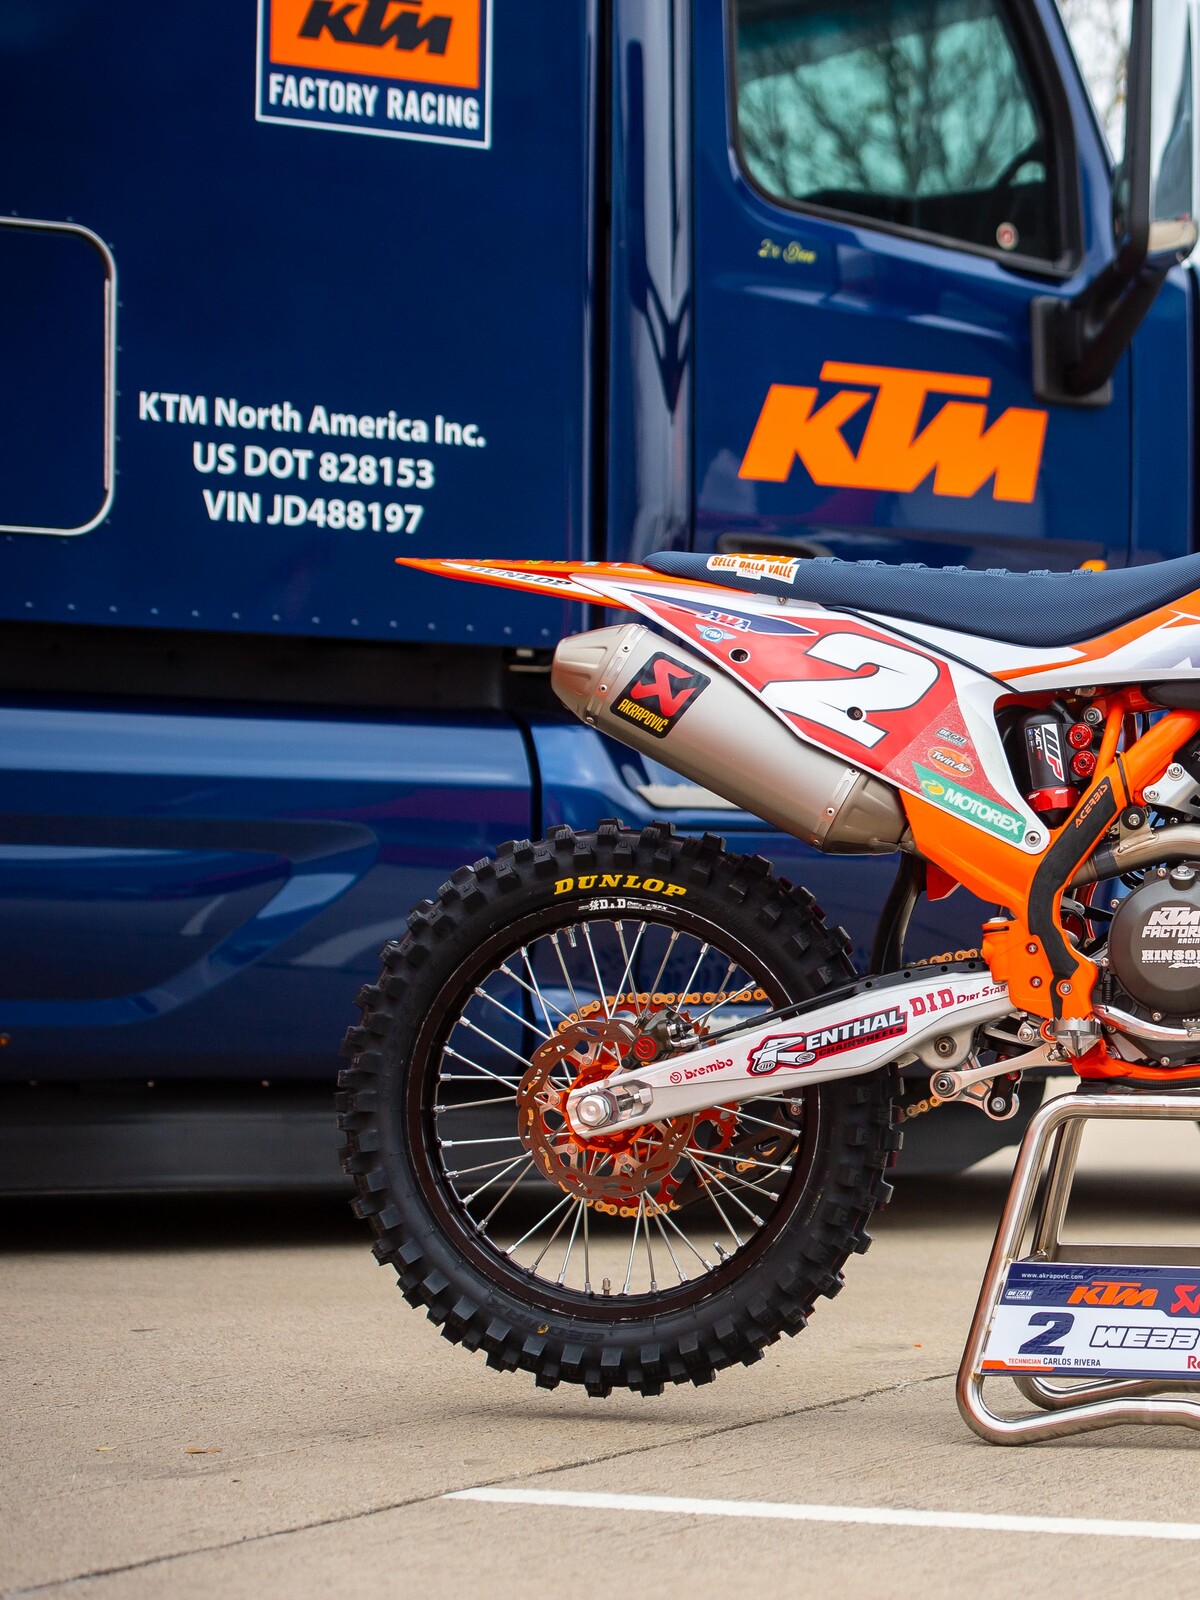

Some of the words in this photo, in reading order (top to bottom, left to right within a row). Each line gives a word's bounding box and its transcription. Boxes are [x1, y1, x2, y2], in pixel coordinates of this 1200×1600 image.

[298, 0, 453, 56] KTM
[269, 72, 379, 118] FACTORY
[386, 86, 480, 130] RACING
[138, 391, 207, 425] KTM
[214, 397, 301, 432] North
[308, 405, 429, 443] America
[434, 415, 486, 448] Inc.
[738, 360, 1048, 502] KTM
[193, 441, 237, 475] US
[244, 446, 314, 480] DOT
[319, 452, 435, 489] 828153
[202, 489, 261, 524] VIN
[266, 494, 424, 534] JD488197
[467, 565, 564, 587] DUNLOP
[711, 556, 737, 568] SELLE
[738, 560, 765, 572] DALLA
[768, 564, 793, 578] VALLE
[705, 630, 721, 640] FIM
[760, 632, 940, 750] 2
[931, 750, 956, 767] Twin
[953, 762, 972, 773] Air
[943, 788, 1026, 835] MOTOREX
[553, 874, 687, 897] DUNLOP
[1147, 907, 1200, 926] KTM
[909, 987, 955, 1017] D.I.D
[819, 1026, 904, 1056] CHAINWHEELS
[685, 1058, 734, 1080] brembo
[1021, 1272, 1084, 1280] www.akrapovic.com
[1067, 1281, 1158, 1307] KTM
[1018, 1311, 1075, 1355] 2
[1089, 1325, 1200, 1351] WEBB
[1008, 1357, 1042, 1365] TECHNICIAN
[1043, 1357, 1072, 1366] CARLOS
[1074, 1358, 1101, 1367] RIVERA
